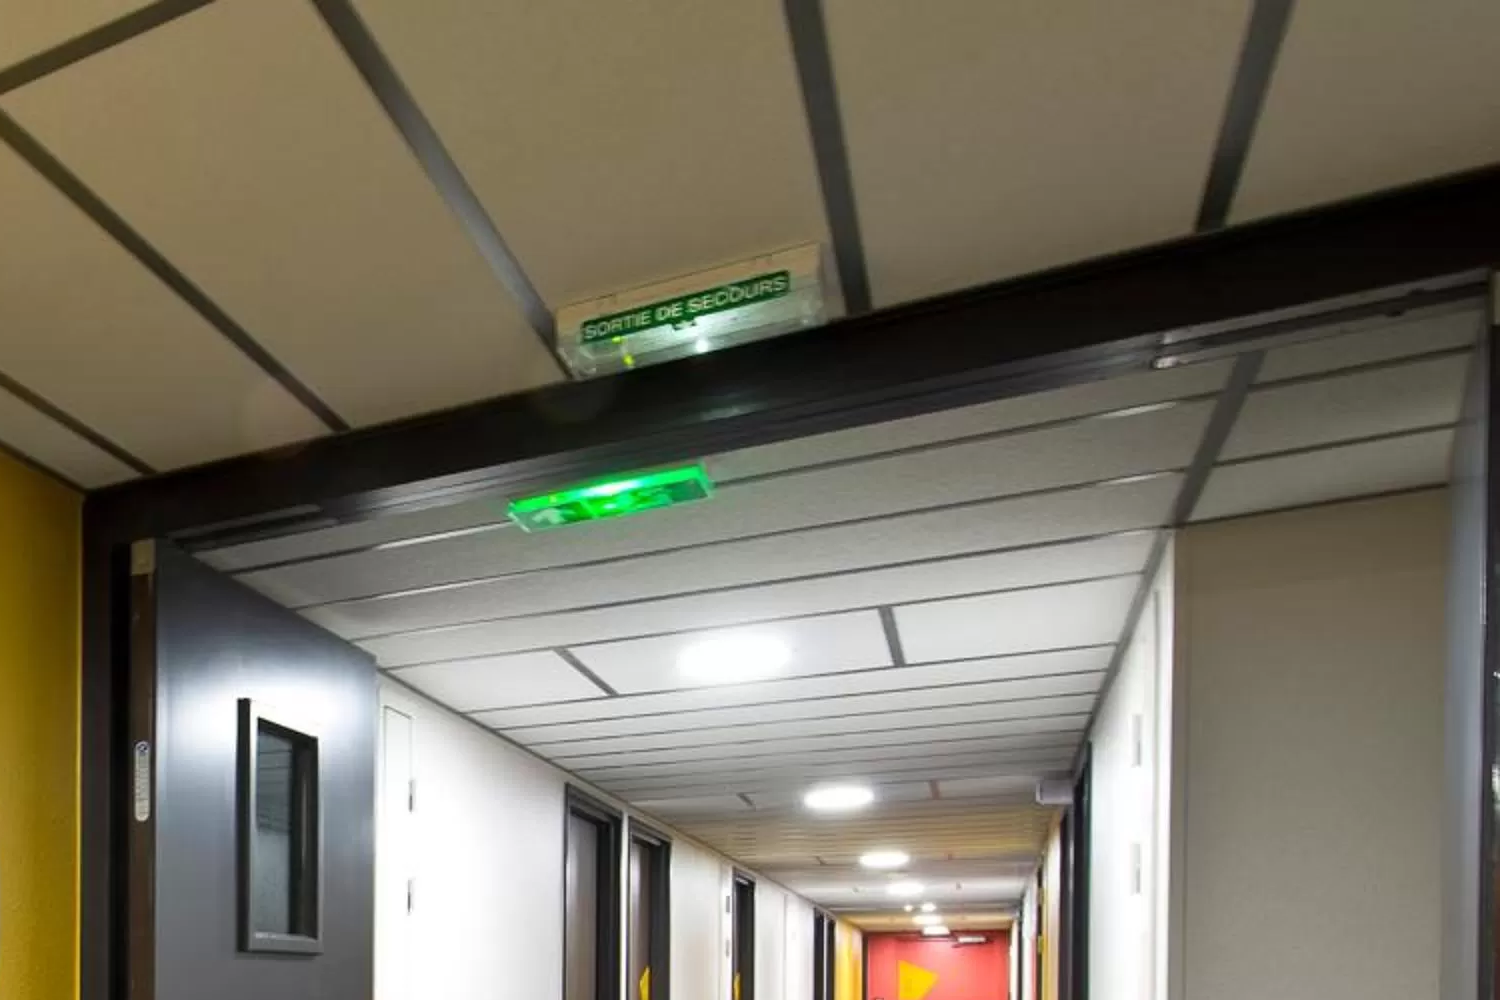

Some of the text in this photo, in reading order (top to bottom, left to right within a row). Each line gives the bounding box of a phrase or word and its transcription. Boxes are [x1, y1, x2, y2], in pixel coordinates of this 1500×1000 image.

[583, 274, 789, 341] SORTIE DE SECOURS
